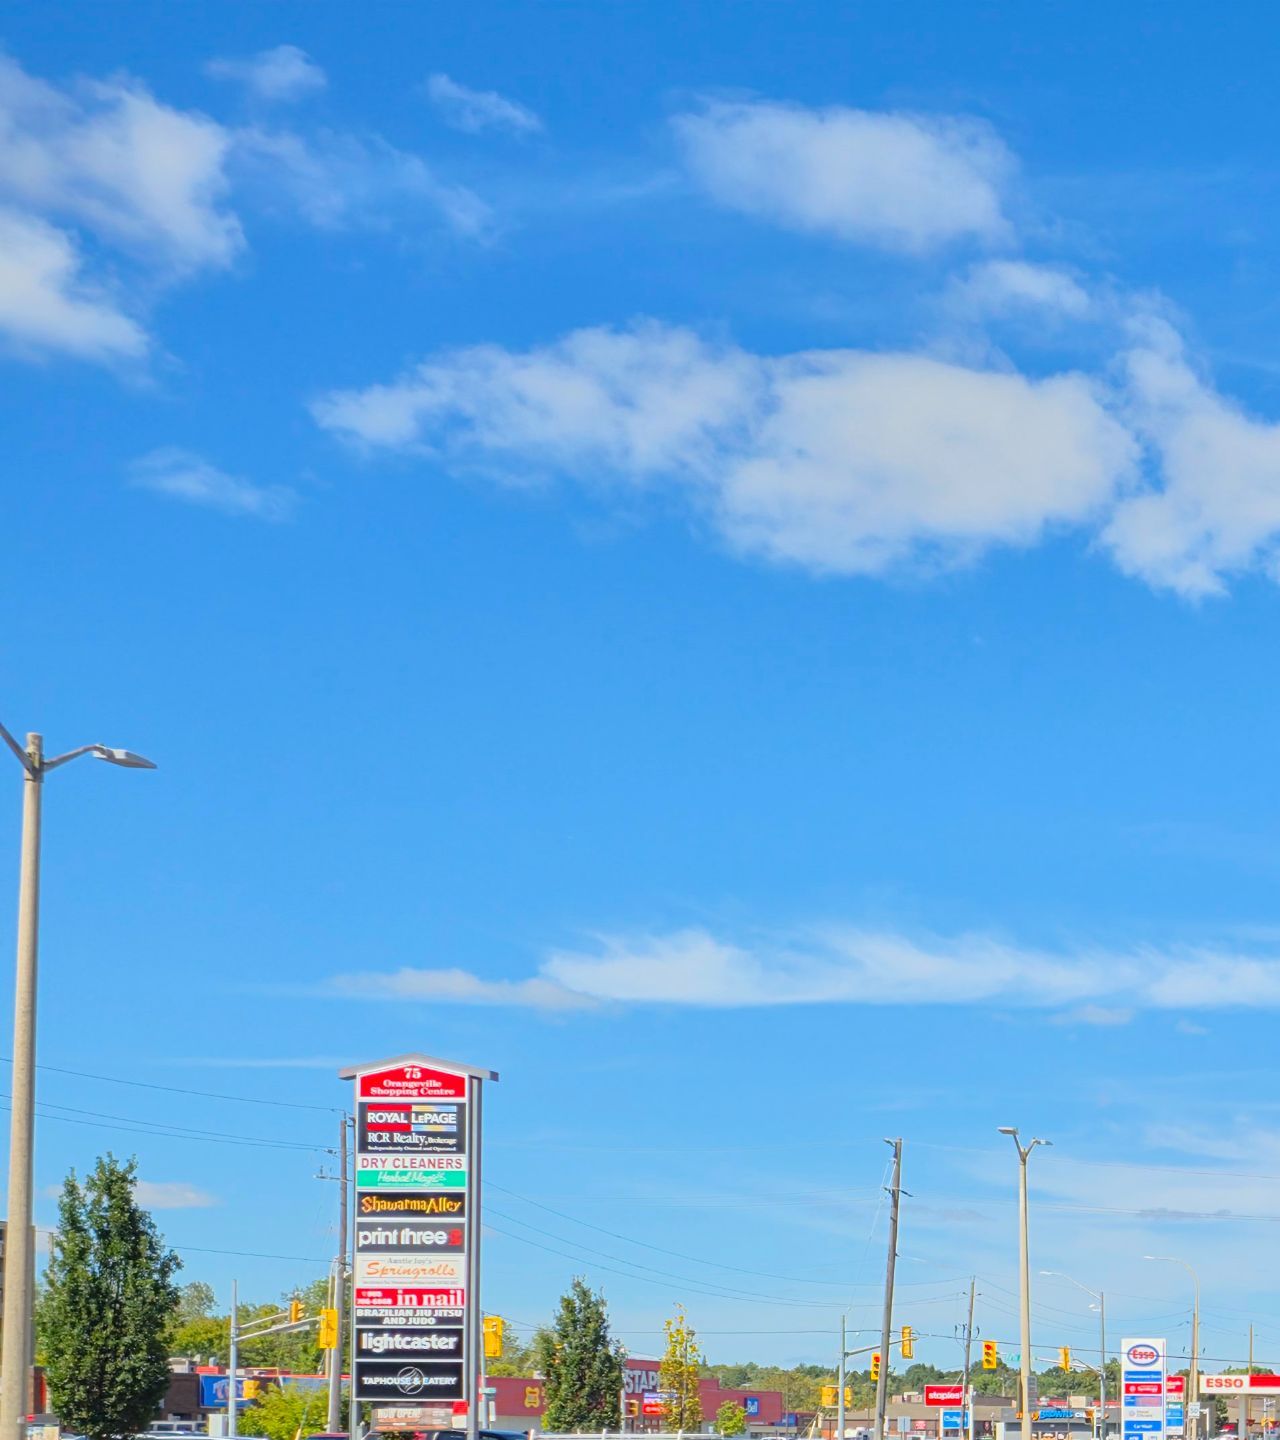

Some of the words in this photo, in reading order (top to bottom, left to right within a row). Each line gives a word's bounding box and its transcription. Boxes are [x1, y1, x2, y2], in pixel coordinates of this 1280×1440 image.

[403, 1067, 422, 1080] 75
[382, 1079, 442, 1089] Orangeville
[370, 1087, 419, 1097] Shopping
[420, 1087, 455, 1095] Centre
[367, 1112, 408, 1124] ROYAL
[367, 1132, 391, 1143] RCR
[361, 1157, 388, 1169] DRY
[392, 1157, 463, 1169] CLEANERS
[358, 1227, 399, 1247] print
[400, 1228, 448, 1246] three
[366, 1261, 456, 1279] Springrolls
[397, 1290, 418, 1306] in
[422, 1290, 463, 1306] nail
[356, 1309, 413, 1317] BRAZILIAN
[413, 1309, 432, 1317] JIU
[433, 1309, 463, 1317] JITSU
[382, 1317, 406, 1325] AND
[407, 1317, 436, 1325] JUDO
[361, 1333, 459, 1353] lightcaster
[1132, 1349, 1155, 1360] Esso
[362, 1376, 412, 1385] TAPHOUSE
[413, 1376, 421, 1385] &
[422, 1376, 458, 1385] EATERY
[625, 1370, 659, 1394] STAP
[1205, 1377, 1244, 1388] ESSO
[928, 1391, 960, 1401] staples
[746, 1400, 758, 1415] Bell
